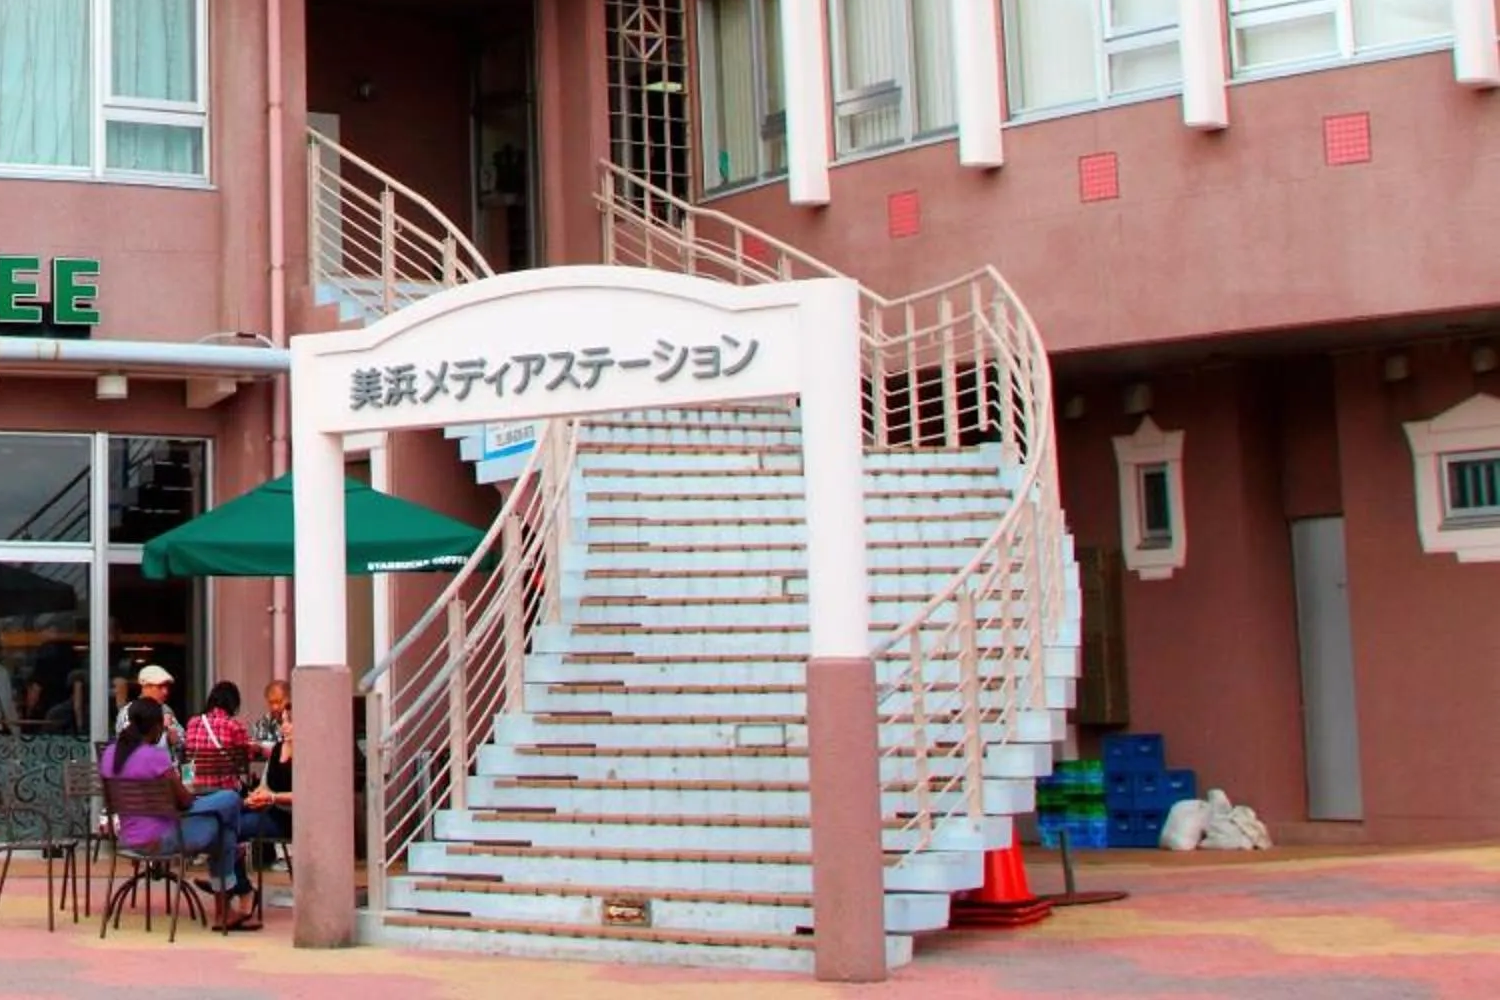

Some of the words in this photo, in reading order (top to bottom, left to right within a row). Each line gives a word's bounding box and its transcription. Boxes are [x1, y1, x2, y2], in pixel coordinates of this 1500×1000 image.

[349, 333, 760, 411] 美浜メディアステーション
